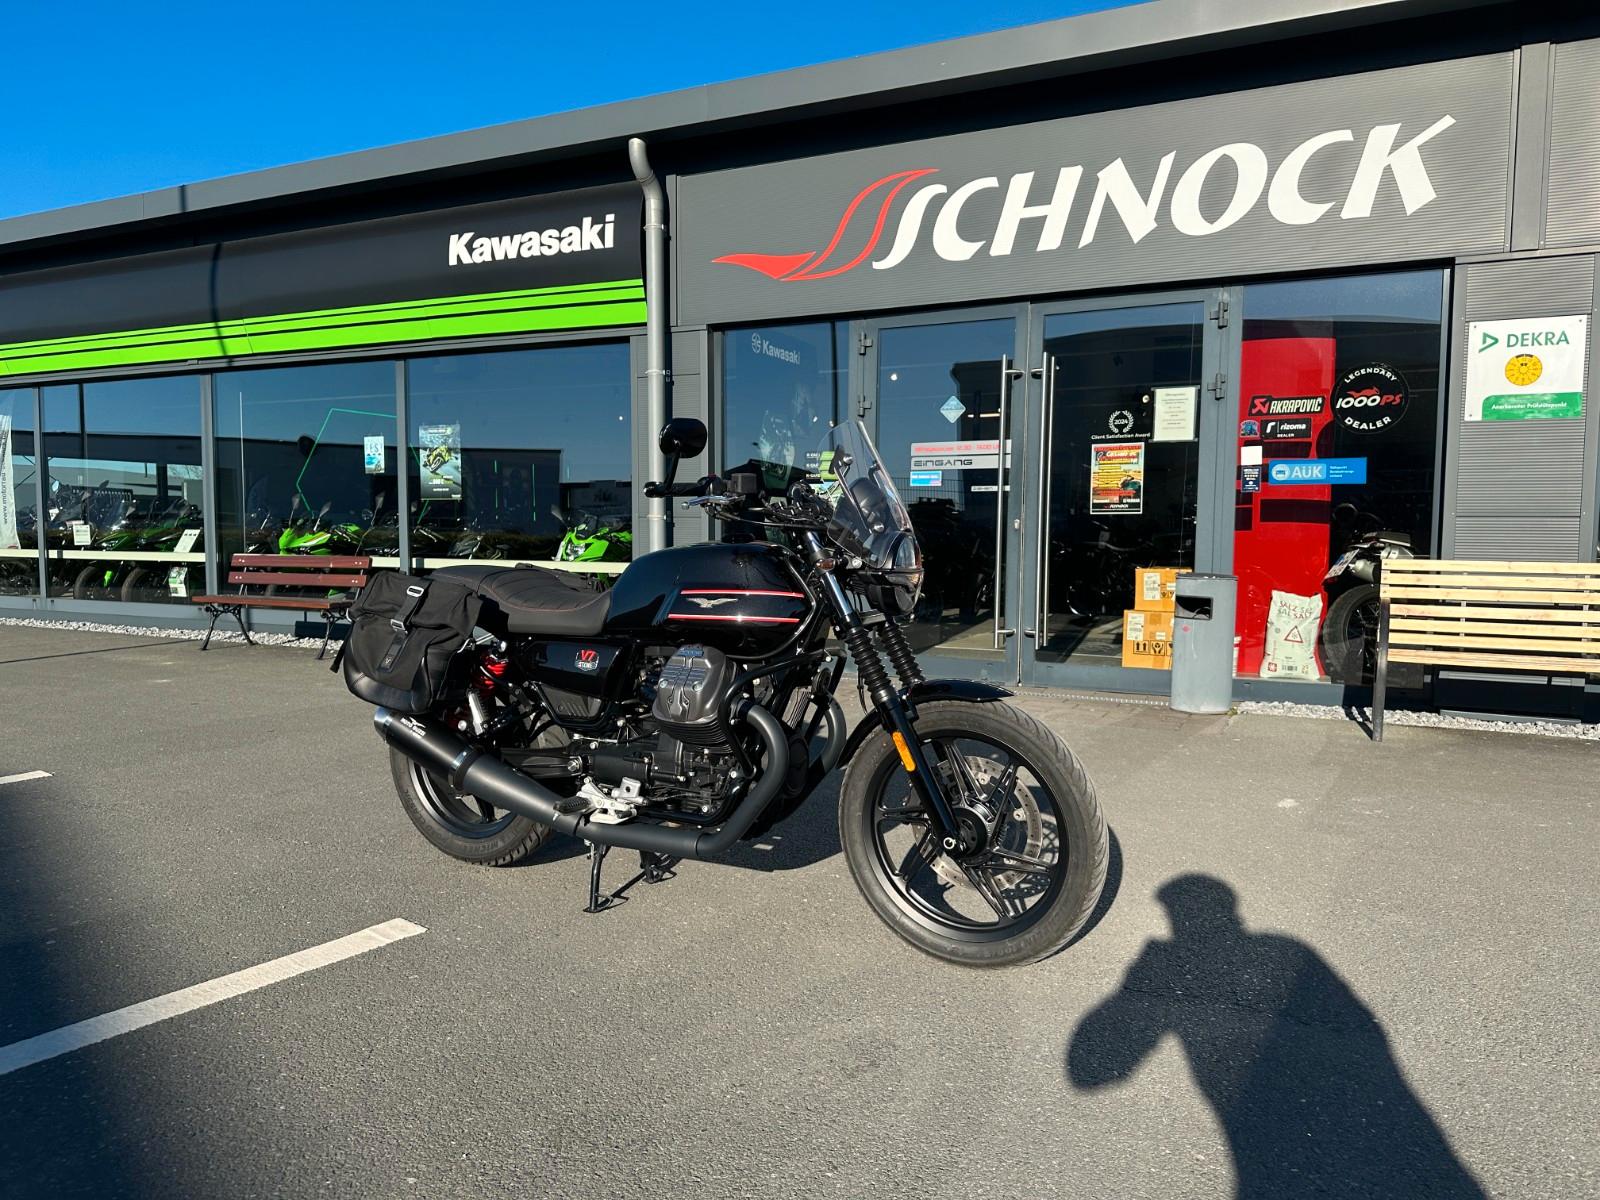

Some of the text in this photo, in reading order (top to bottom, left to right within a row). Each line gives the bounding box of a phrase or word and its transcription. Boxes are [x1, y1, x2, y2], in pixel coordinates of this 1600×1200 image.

[873, 113, 1457, 270] SCHNOCK
[449, 213, 615, 266] Kawasaki
[1506, 331, 1570, 348] DEKRA
[762, 339, 800, 365] Kawasaki
[1344, 367, 1397, 383] LEGENDARY
[1336, 394, 1403, 408] 1000PS
[1344, 416, 1392, 430] DEALER
[1292, 465, 1323, 478] AUK
[581, 649, 595, 661] V7
